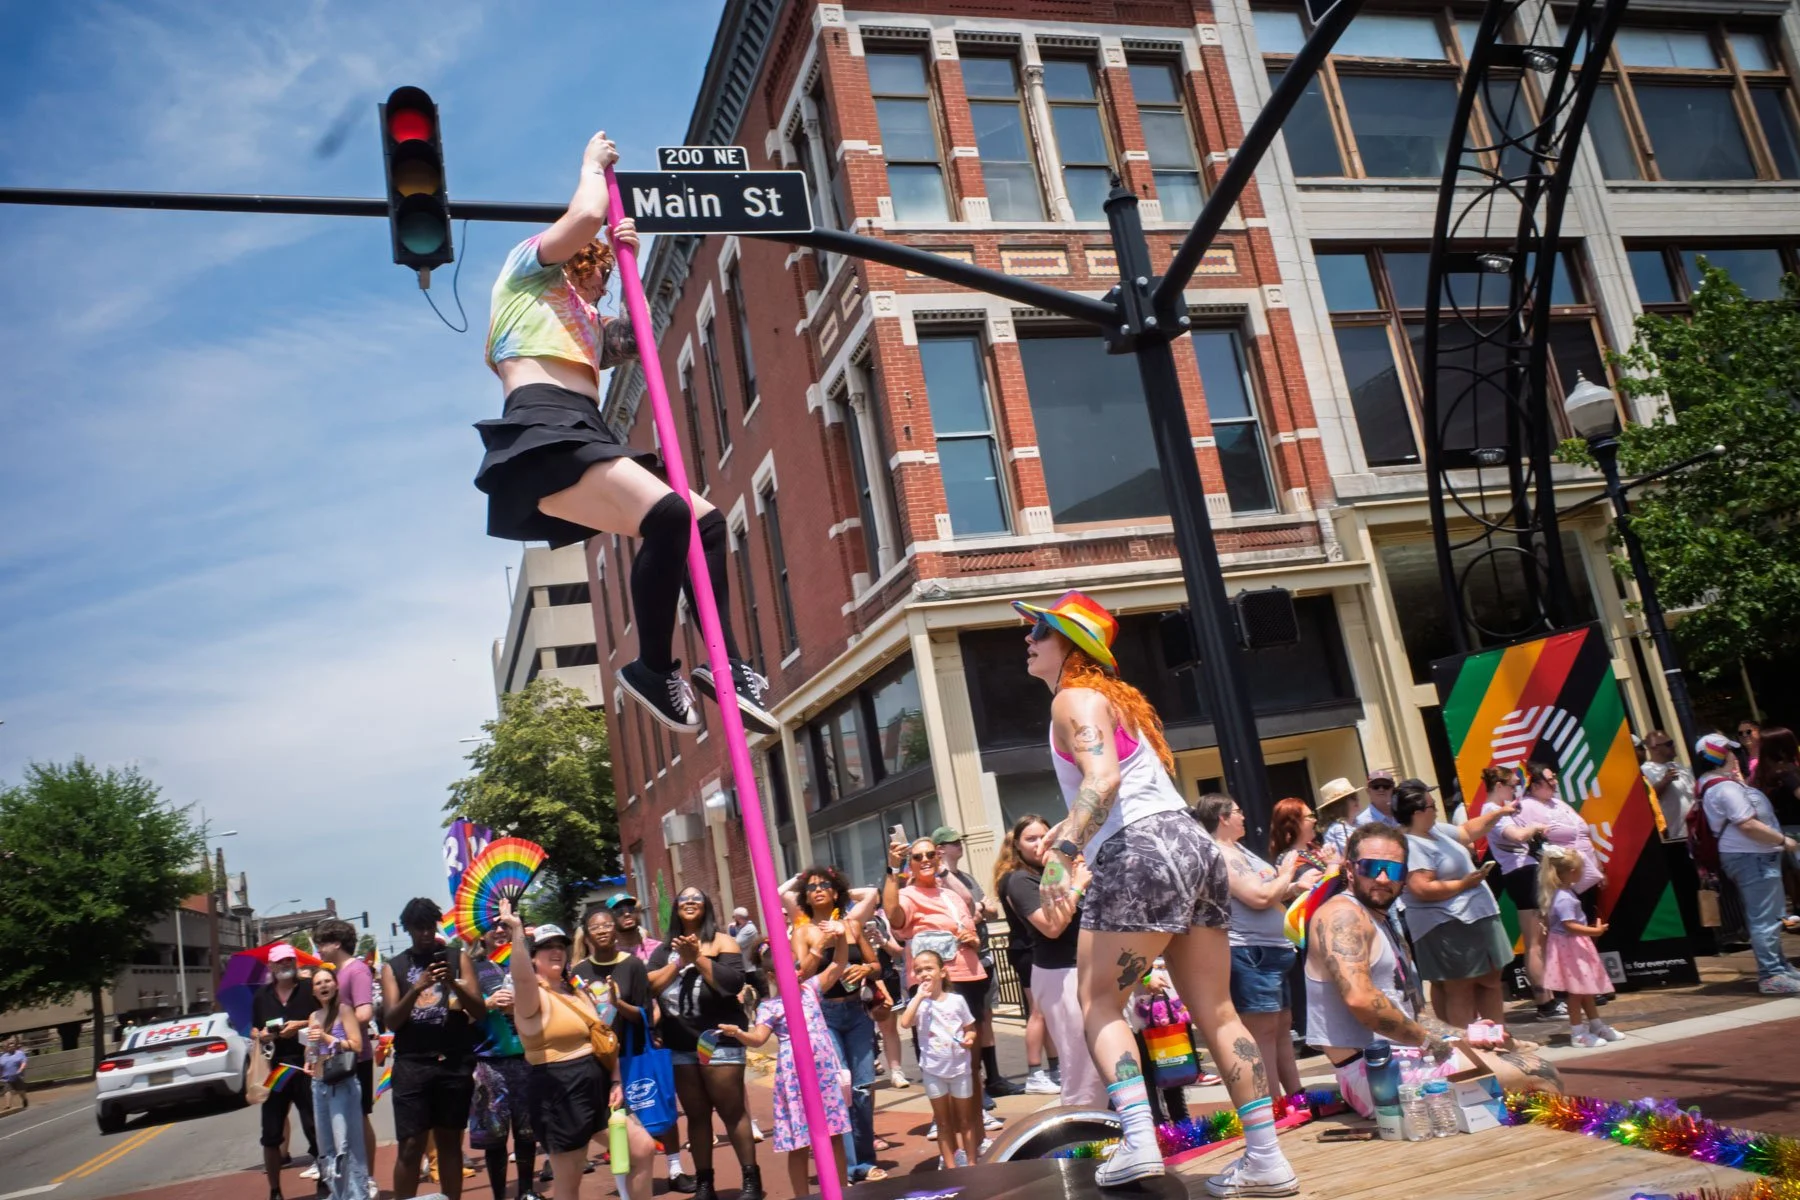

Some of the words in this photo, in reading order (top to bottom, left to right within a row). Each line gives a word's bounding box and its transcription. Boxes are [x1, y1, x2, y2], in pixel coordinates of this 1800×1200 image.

[665, 149, 704, 165] 200
[714, 149, 740, 165] NE
[632, 187, 722, 218] Main
[743, 186, 784, 218] St
[1633, 961, 1646, 969] for
[146, 1022, 203, 1038] HOT
